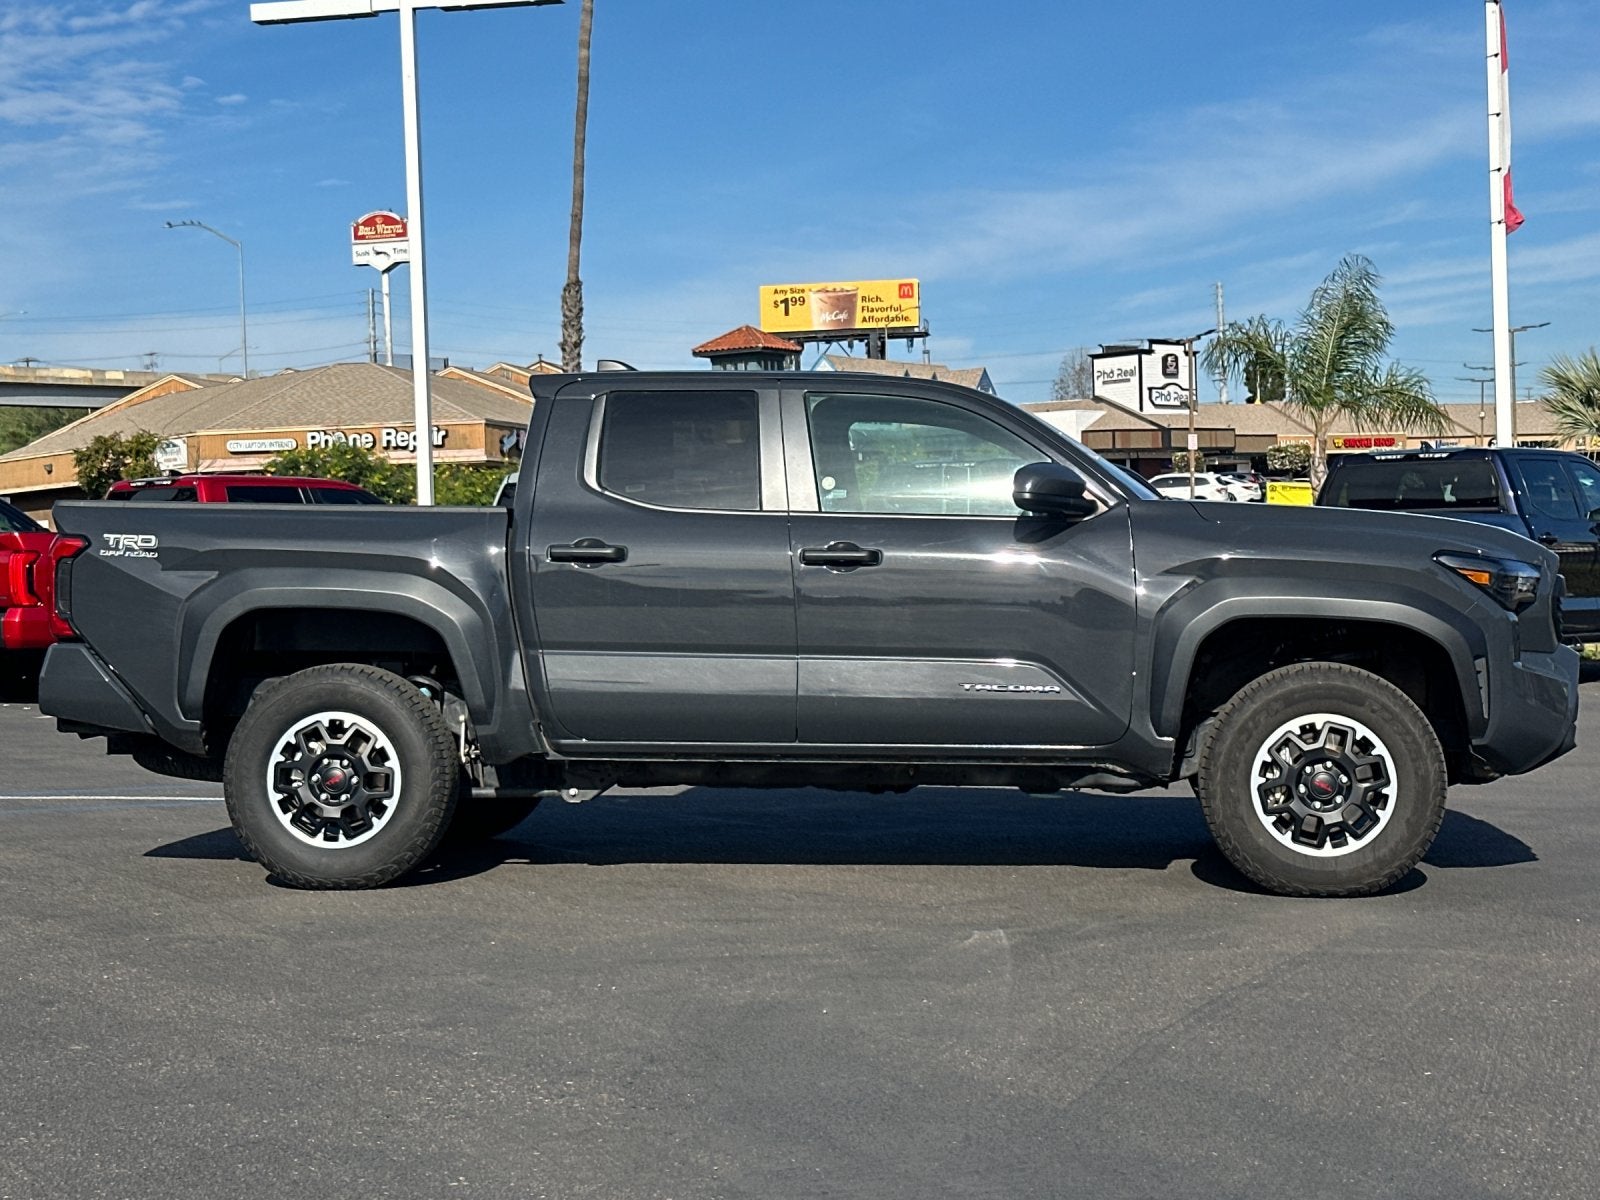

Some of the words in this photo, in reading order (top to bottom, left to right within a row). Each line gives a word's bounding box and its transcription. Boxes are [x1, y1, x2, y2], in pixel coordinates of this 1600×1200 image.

[773, 288, 788, 296] Any
[789, 287, 806, 295] Size
[1116, 365, 1137, 378] Real
[1173, 391, 1189, 402] Rea
[382, 426, 447, 451] Repir
[103, 533, 158, 550] TRD
[959, 683, 1061, 694] TACOMA
